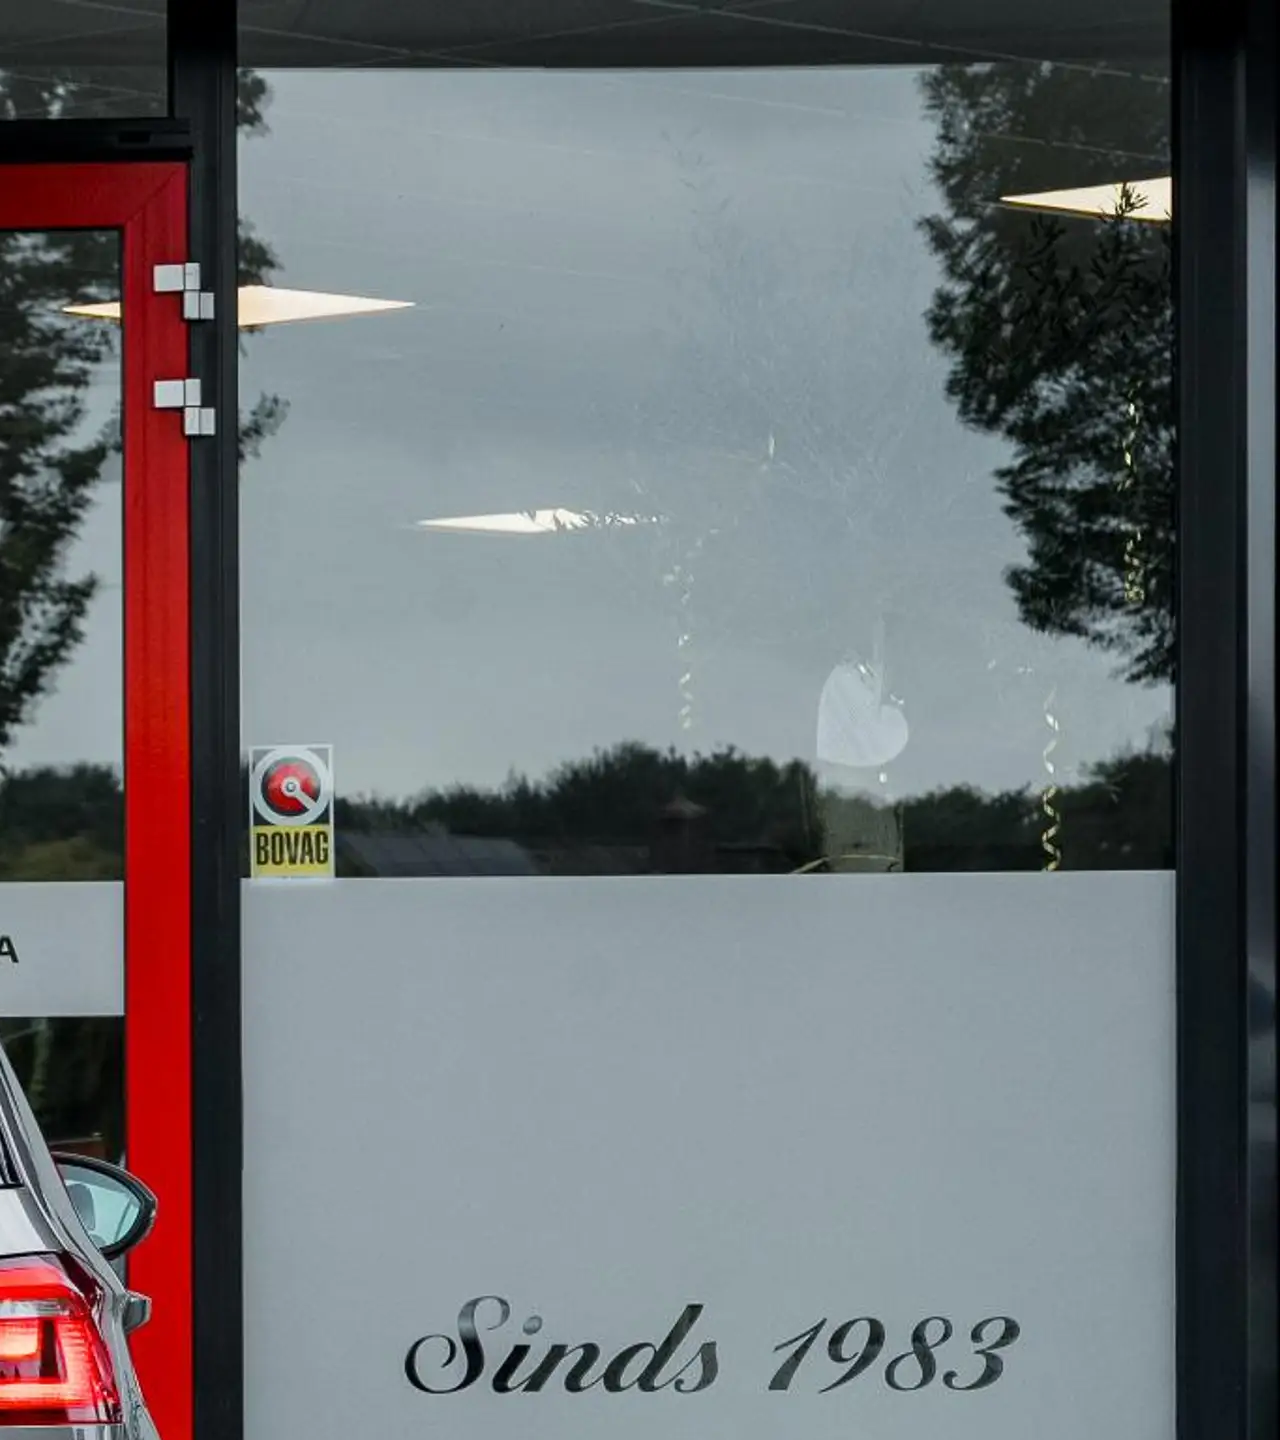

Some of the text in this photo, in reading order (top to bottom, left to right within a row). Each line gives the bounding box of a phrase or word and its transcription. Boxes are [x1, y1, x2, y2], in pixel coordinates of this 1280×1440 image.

[256, 830, 329, 866] BOVAG
[404, 1295, 1021, 1394] Sinds 1983
